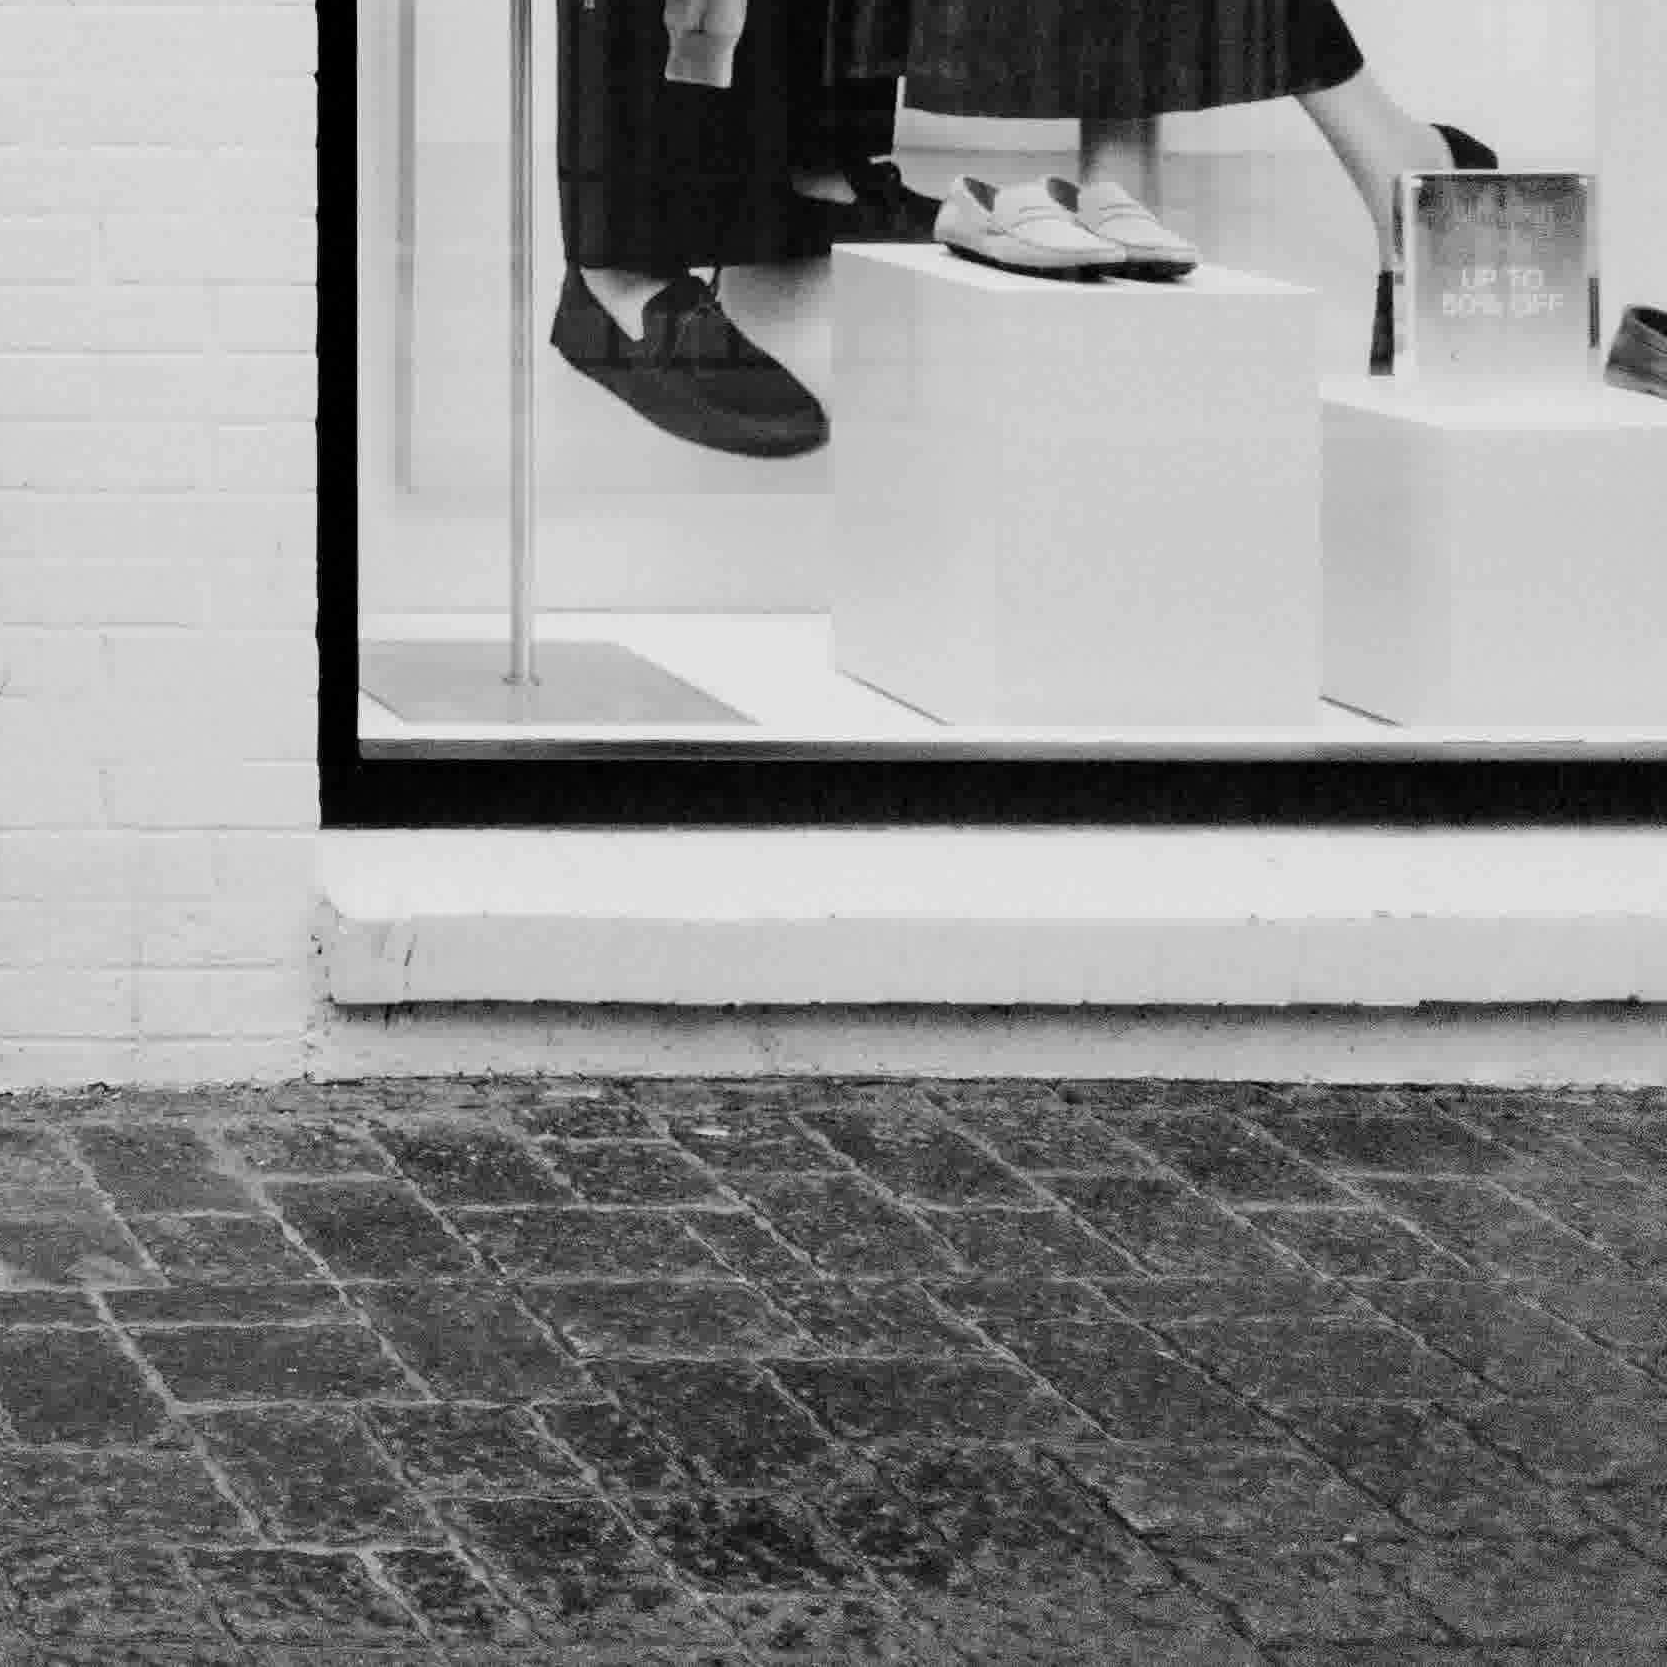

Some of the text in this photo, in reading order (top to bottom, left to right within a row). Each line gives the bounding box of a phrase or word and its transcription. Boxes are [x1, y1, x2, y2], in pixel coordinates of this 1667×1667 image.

[1461, 268, 1545, 291] UP TO
[1510, 293, 1564, 316] OFF
